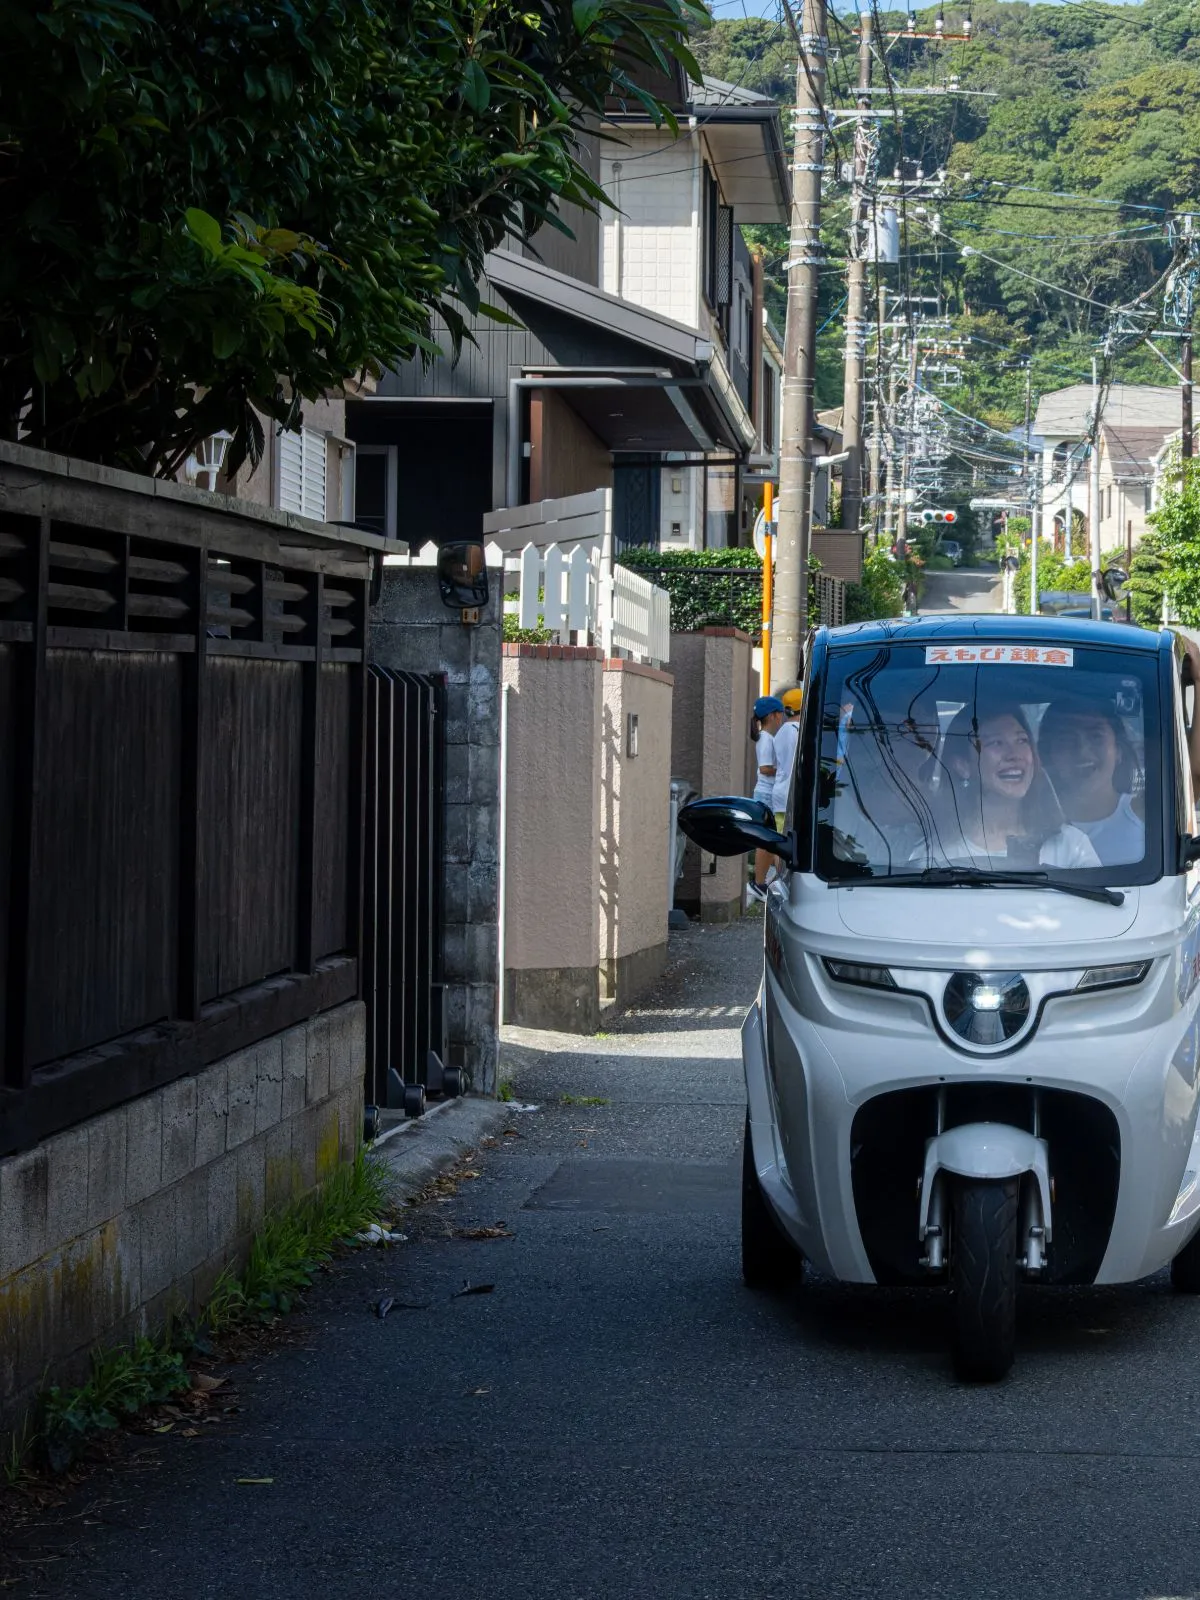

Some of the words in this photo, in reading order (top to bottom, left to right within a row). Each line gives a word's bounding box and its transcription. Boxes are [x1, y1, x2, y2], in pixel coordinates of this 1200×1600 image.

[929, 647, 1071, 664] えもび鎌倉
